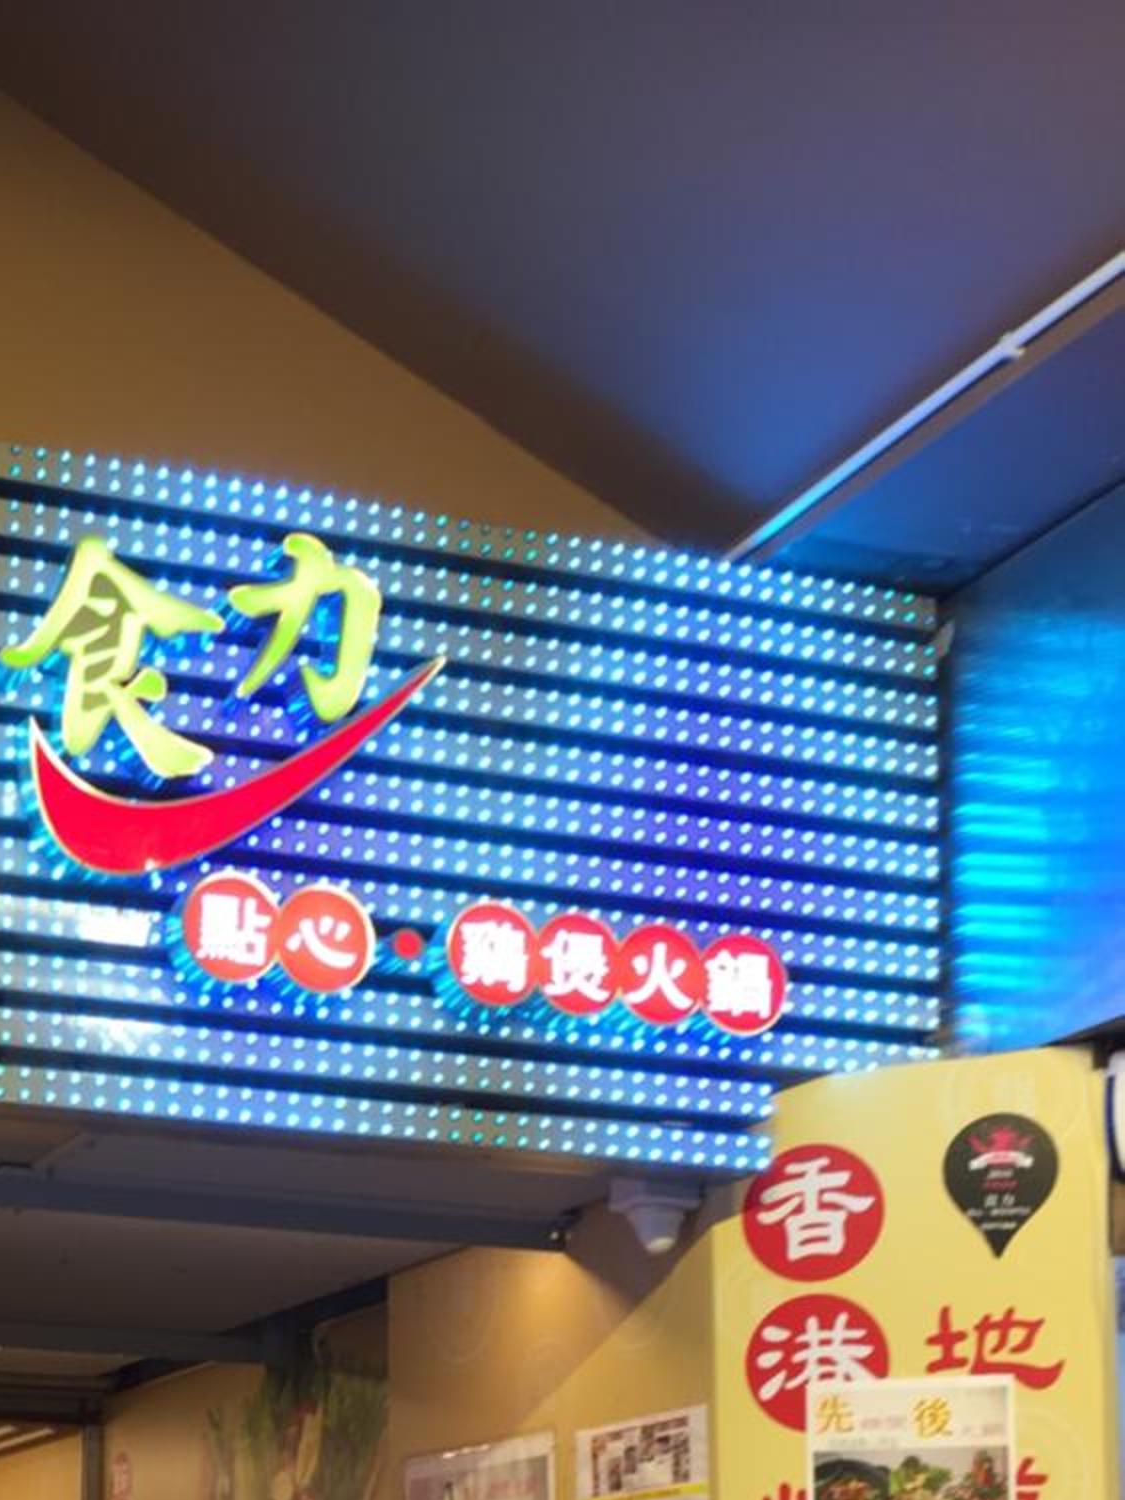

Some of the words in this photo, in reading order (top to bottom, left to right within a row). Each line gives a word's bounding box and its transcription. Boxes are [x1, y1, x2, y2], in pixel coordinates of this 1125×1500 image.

[194, 888, 360, 972] 點心
[814, 1396, 856, 1434] 先
[913, 1398, 956, 1438] 後
